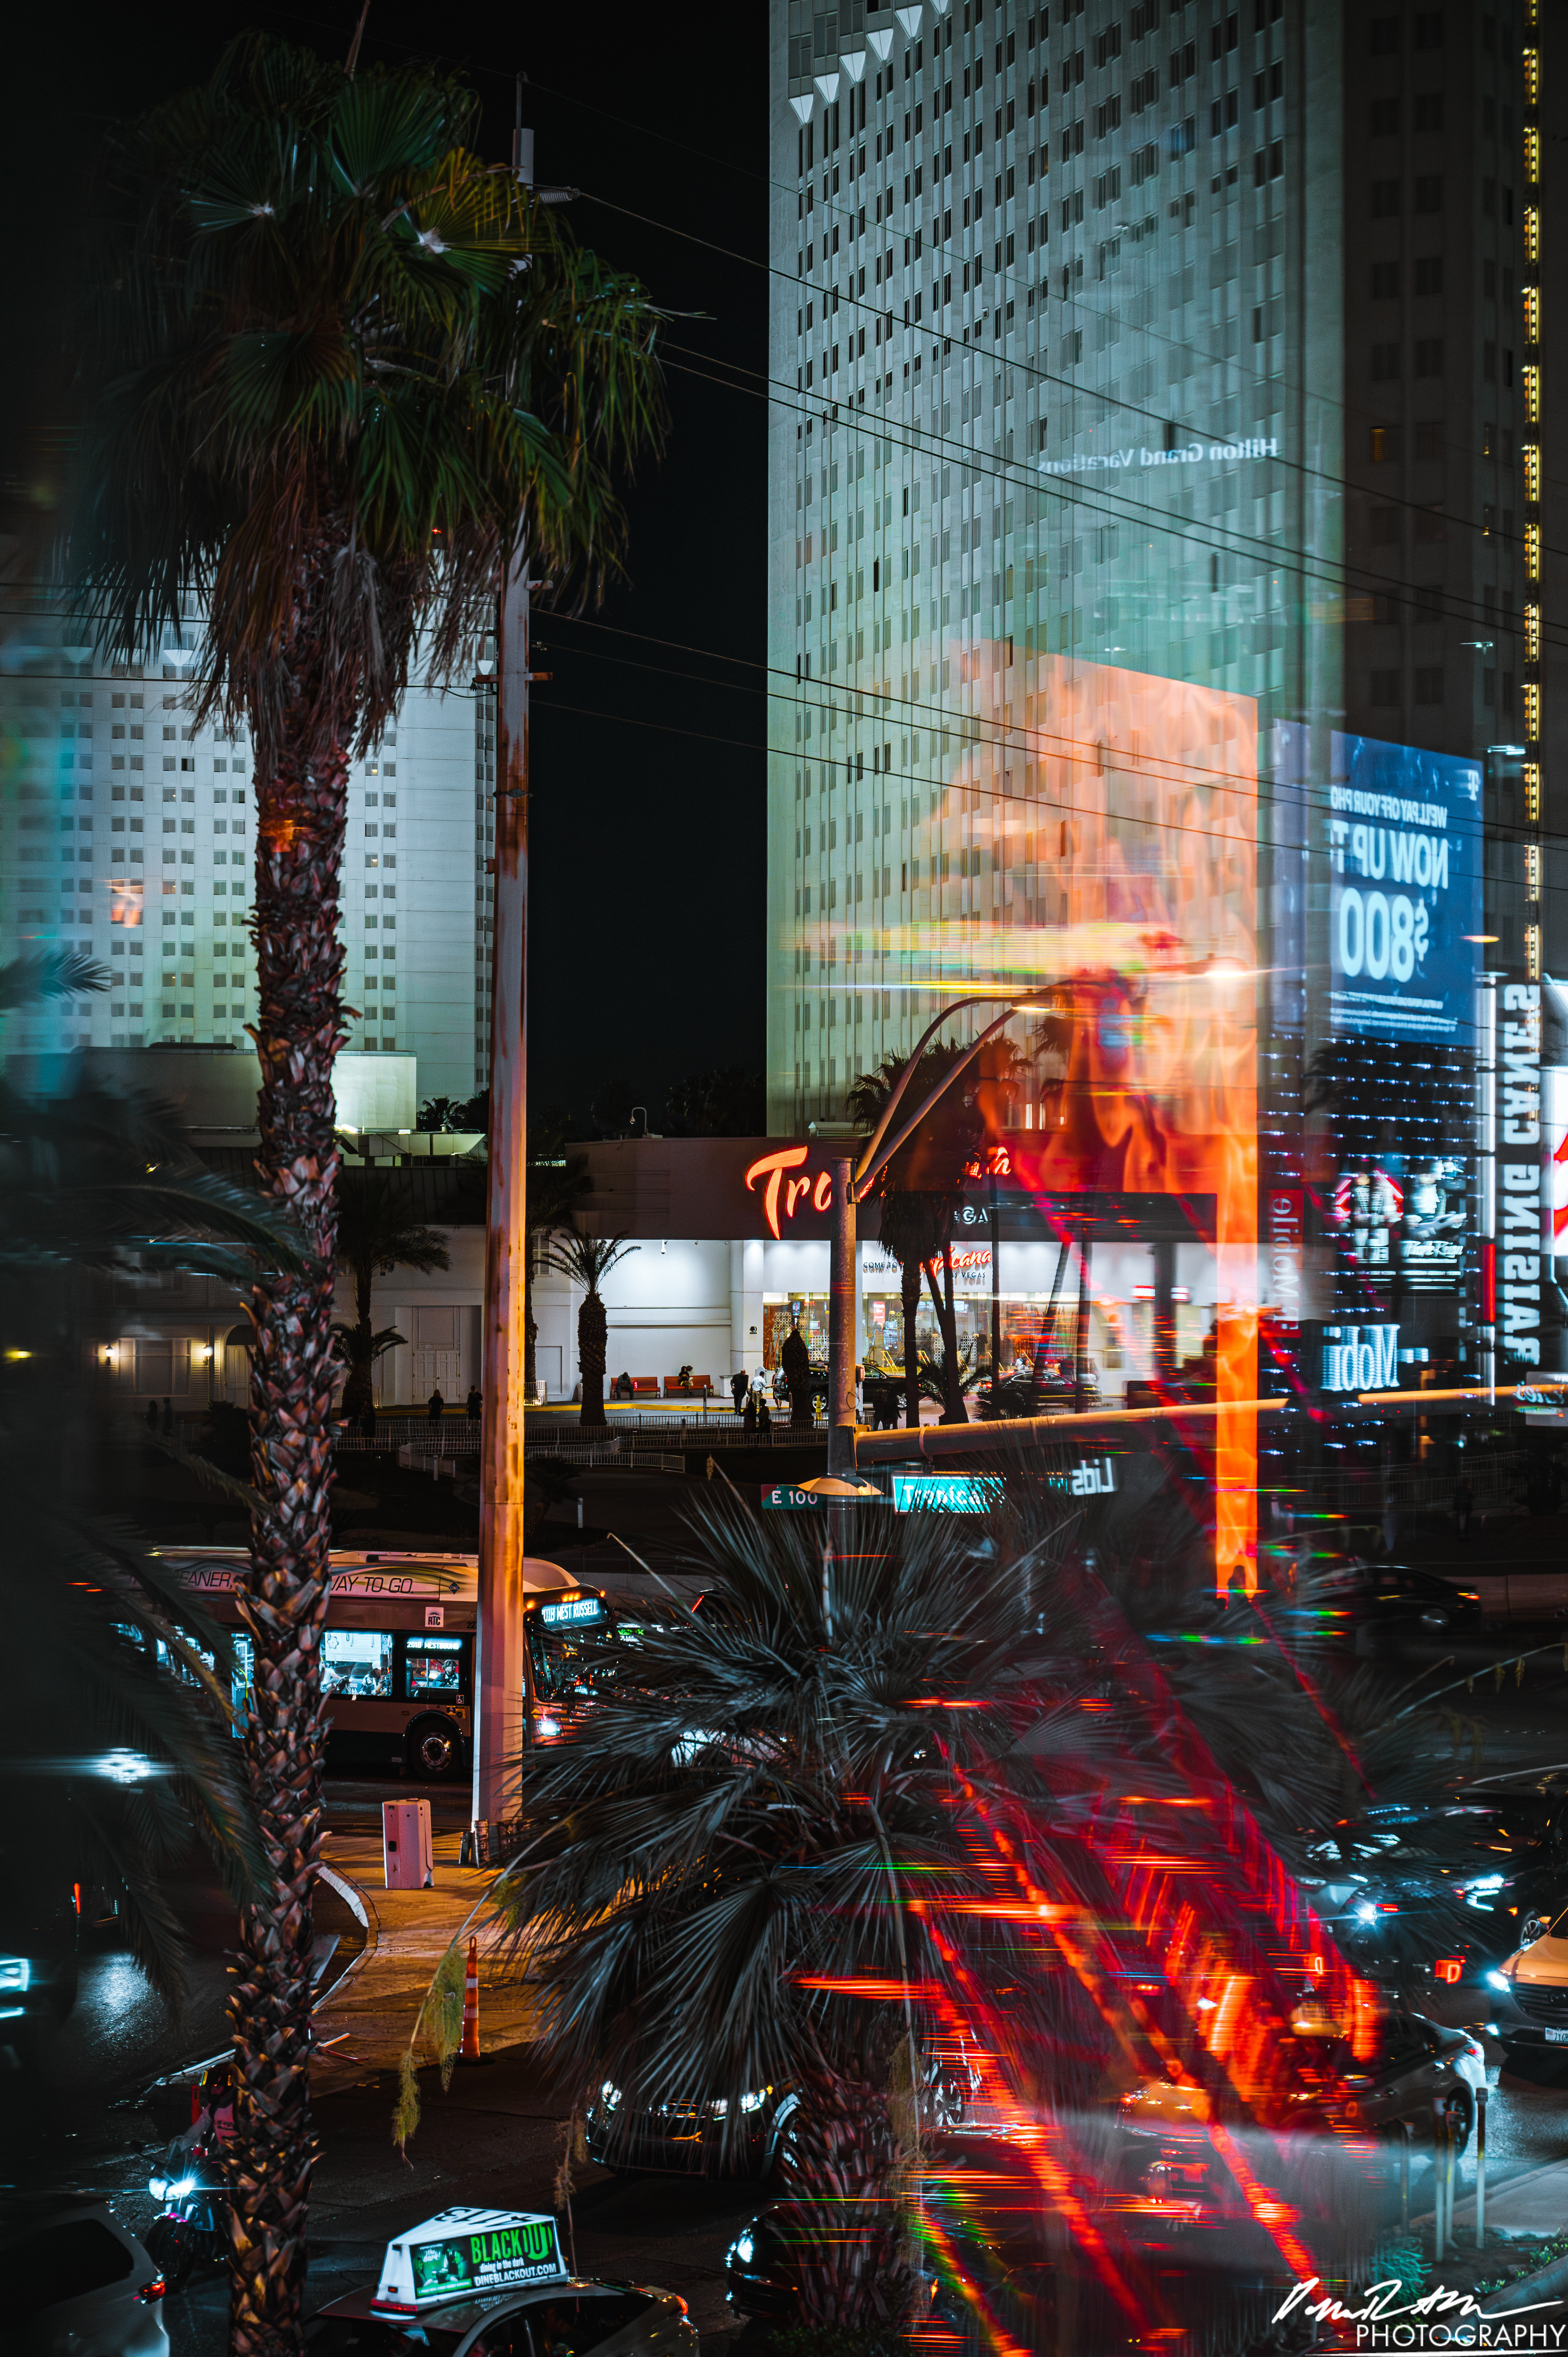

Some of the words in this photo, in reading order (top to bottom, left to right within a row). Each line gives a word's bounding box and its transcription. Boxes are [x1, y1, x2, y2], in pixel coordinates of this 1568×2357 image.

[772, 1491, 781, 1504] E
[788, 1491, 818, 1505] 100
[365, 1577, 383, 1592] TO
[388, 1578, 414, 1594] GO.
[557, 1604, 572, 1621] WEST
[573, 1601, 597, 1618] RUSSELL
[428, 1616, 441, 1626] RTC
[424, 1641, 459, 1650] WESTBOUND
[470, 2222, 553, 2263] BLACKOUT
[479, 2262, 496, 2273] dining
[497, 2261, 502, 2269] in
[503, 2259, 511, 2269] the
[512, 2257, 524, 2268] dark
[473, 2263, 556, 2287] DINEBLACKOUT.COM
